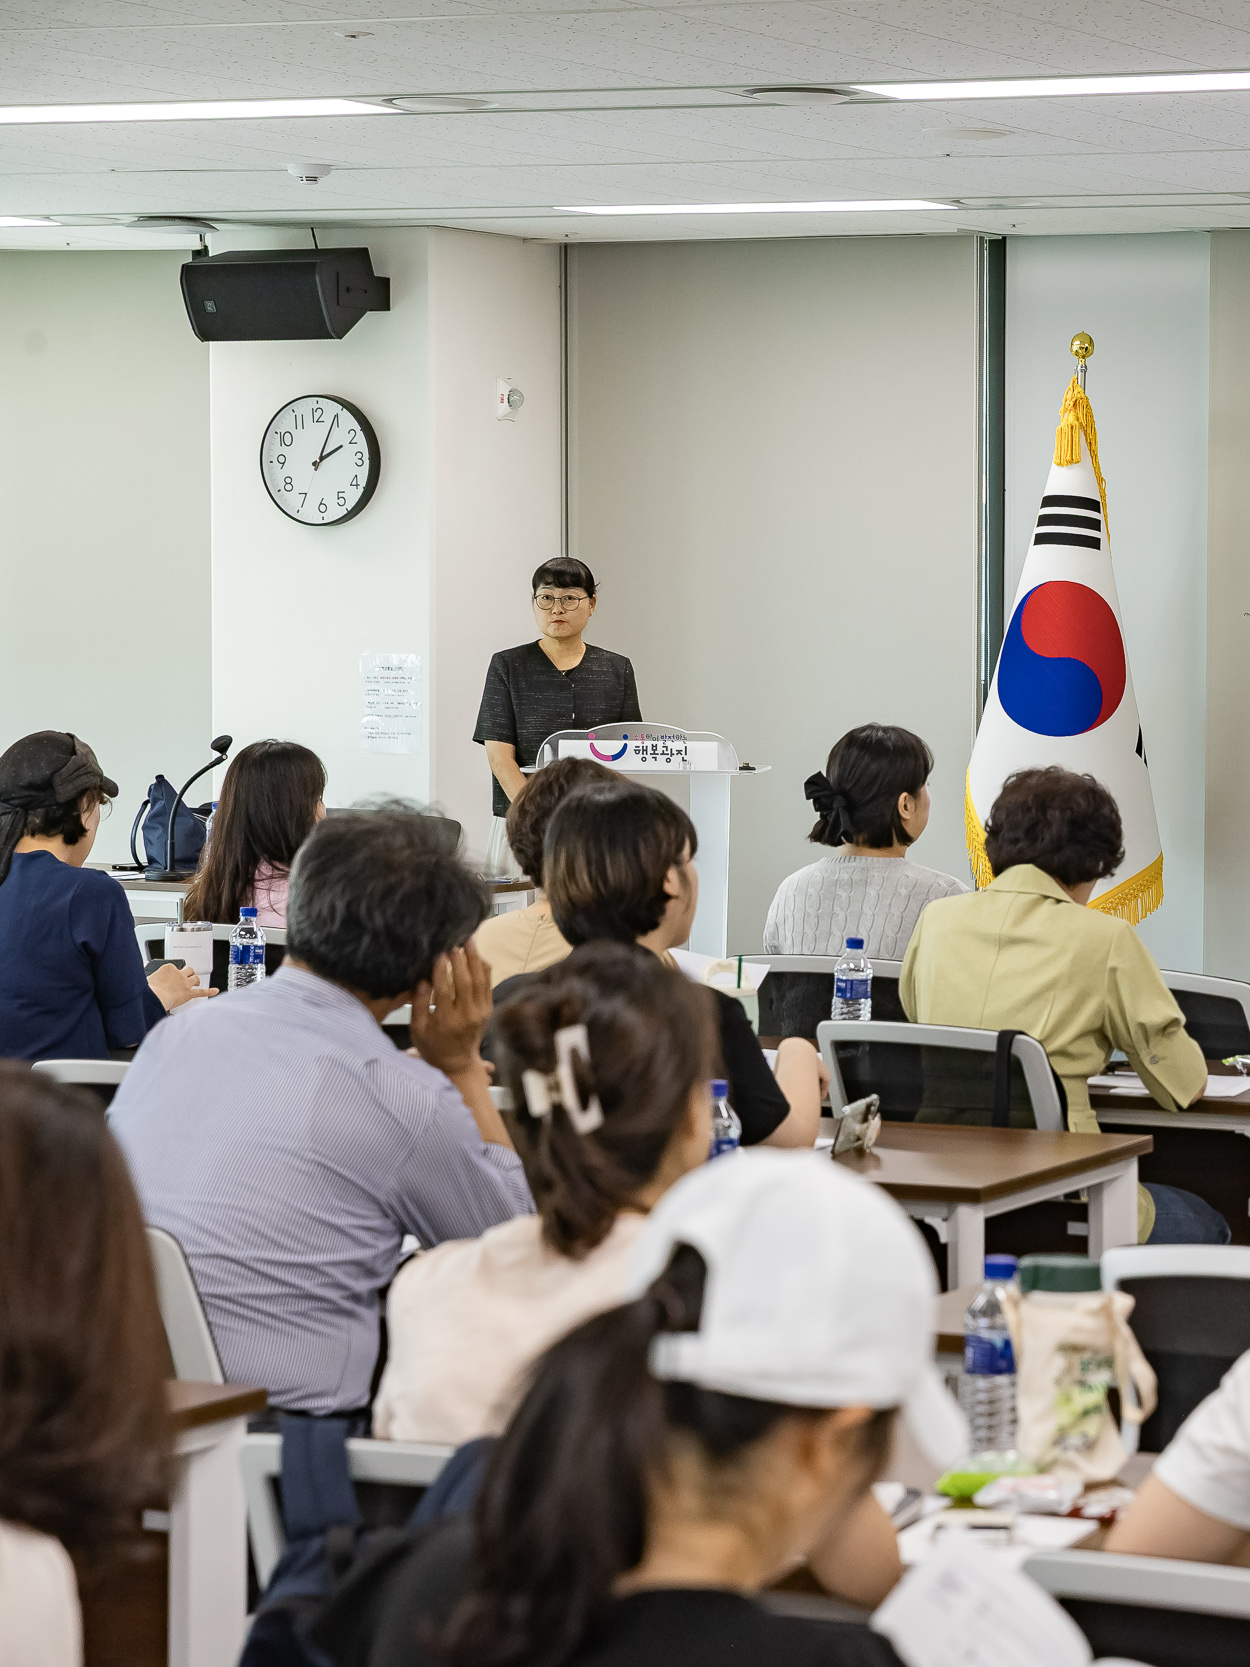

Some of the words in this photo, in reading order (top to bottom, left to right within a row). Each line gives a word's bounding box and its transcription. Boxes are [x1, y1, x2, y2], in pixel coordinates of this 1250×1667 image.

[294, 414, 304, 430] 11
[312, 407, 325, 423] 12
[279, 431, 293, 447] 10
[347, 428, 358, 444] 2
[276, 454, 286, 469] 9
[354, 451, 364, 467] 3
[283, 476, 294, 492] 8
[349, 474, 360, 489] 4
[298, 492, 307, 508] 7
[318, 498, 328, 513] 6
[336, 491, 346, 506] 5
[633, 744, 688, 763] 행복광진
